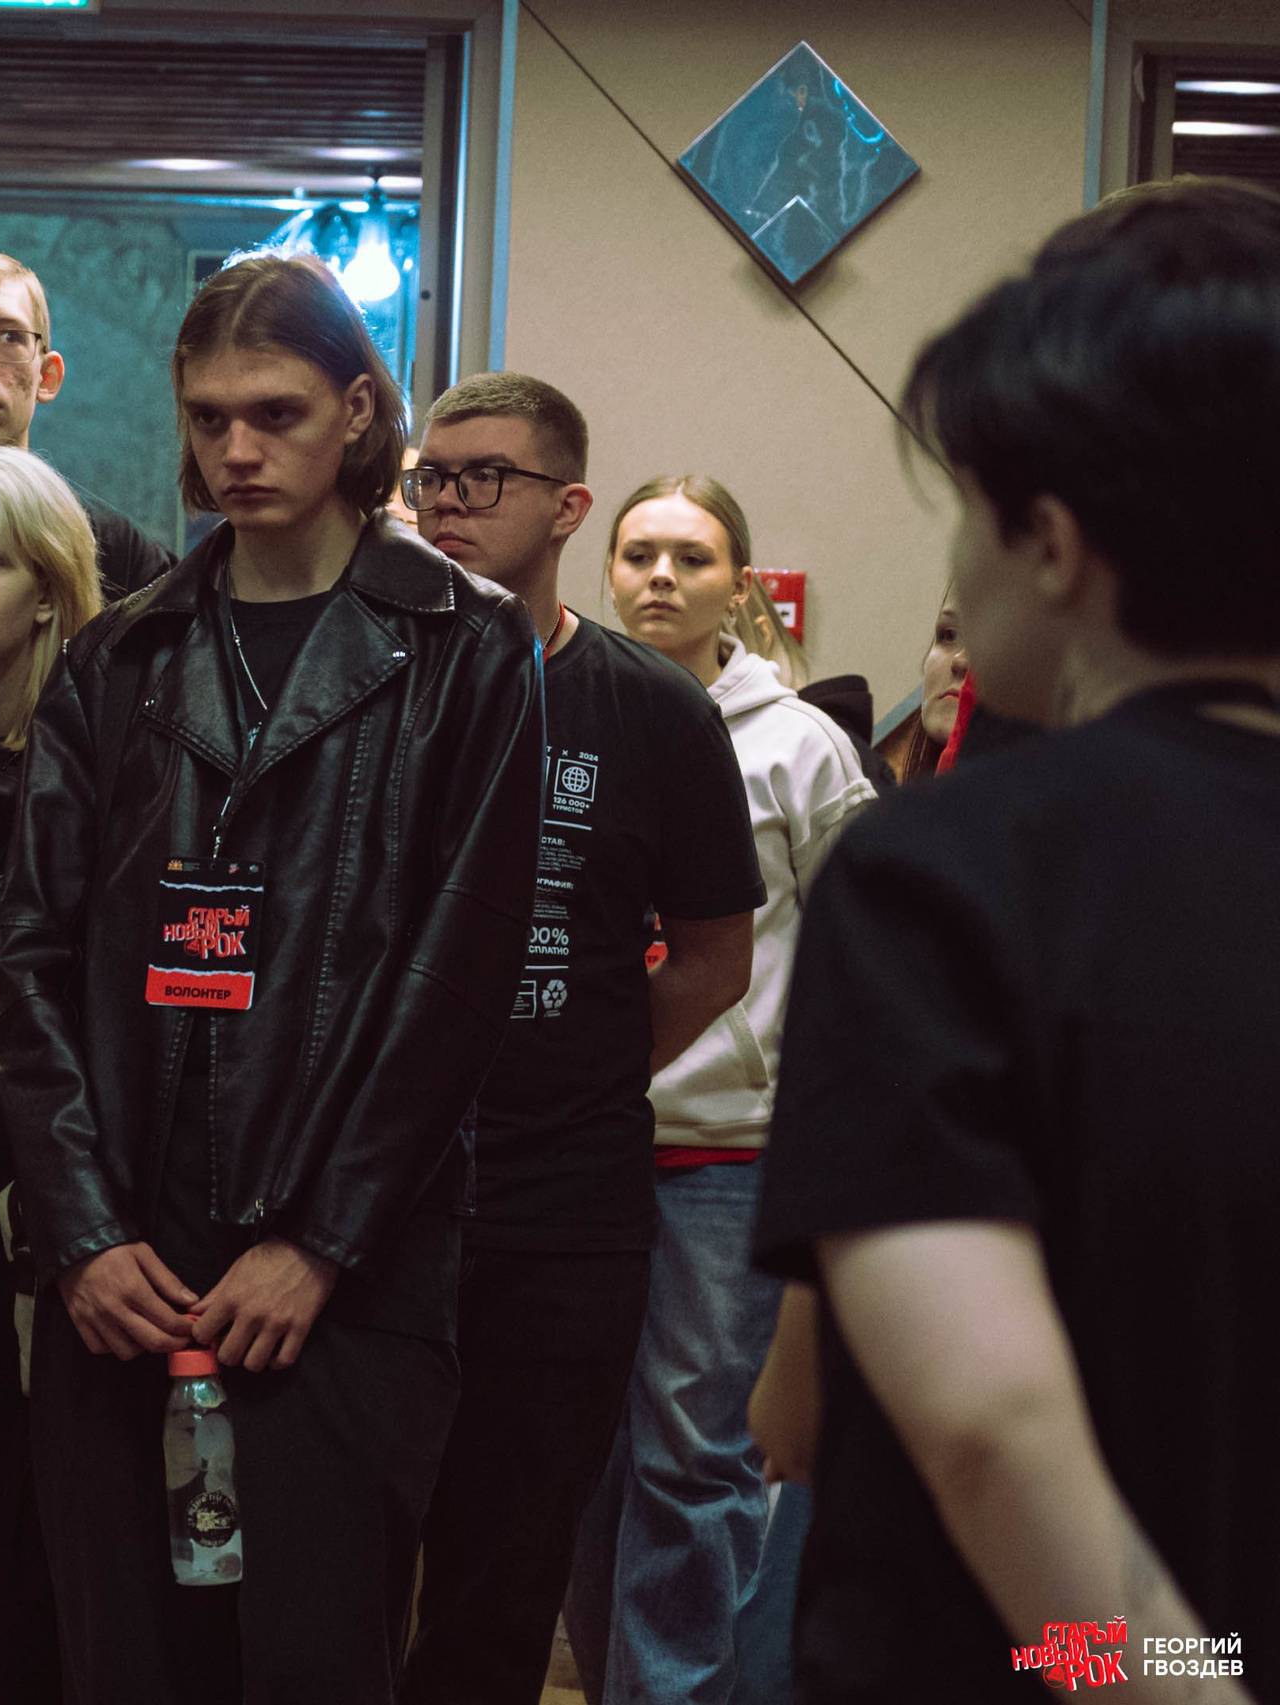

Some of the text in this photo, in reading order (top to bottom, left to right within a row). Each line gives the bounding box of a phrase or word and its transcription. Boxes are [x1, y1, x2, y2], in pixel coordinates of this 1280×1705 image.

[579, 752, 599, 762] 2024
[553, 796, 567, 805] 126
[541, 836, 566, 846] СТАВ:
[537, 878, 574, 889] ГРАФИЯ:
[188, 905, 250, 926] СТАРЫЙ
[163, 919, 220, 941] НОВЫЙ
[530, 926, 569, 945] 00%
[201, 931, 246, 959] РОК
[528, 945, 569, 956] СПЛАТНО
[165, 986, 231, 1000] ВОЛОНТЕР
